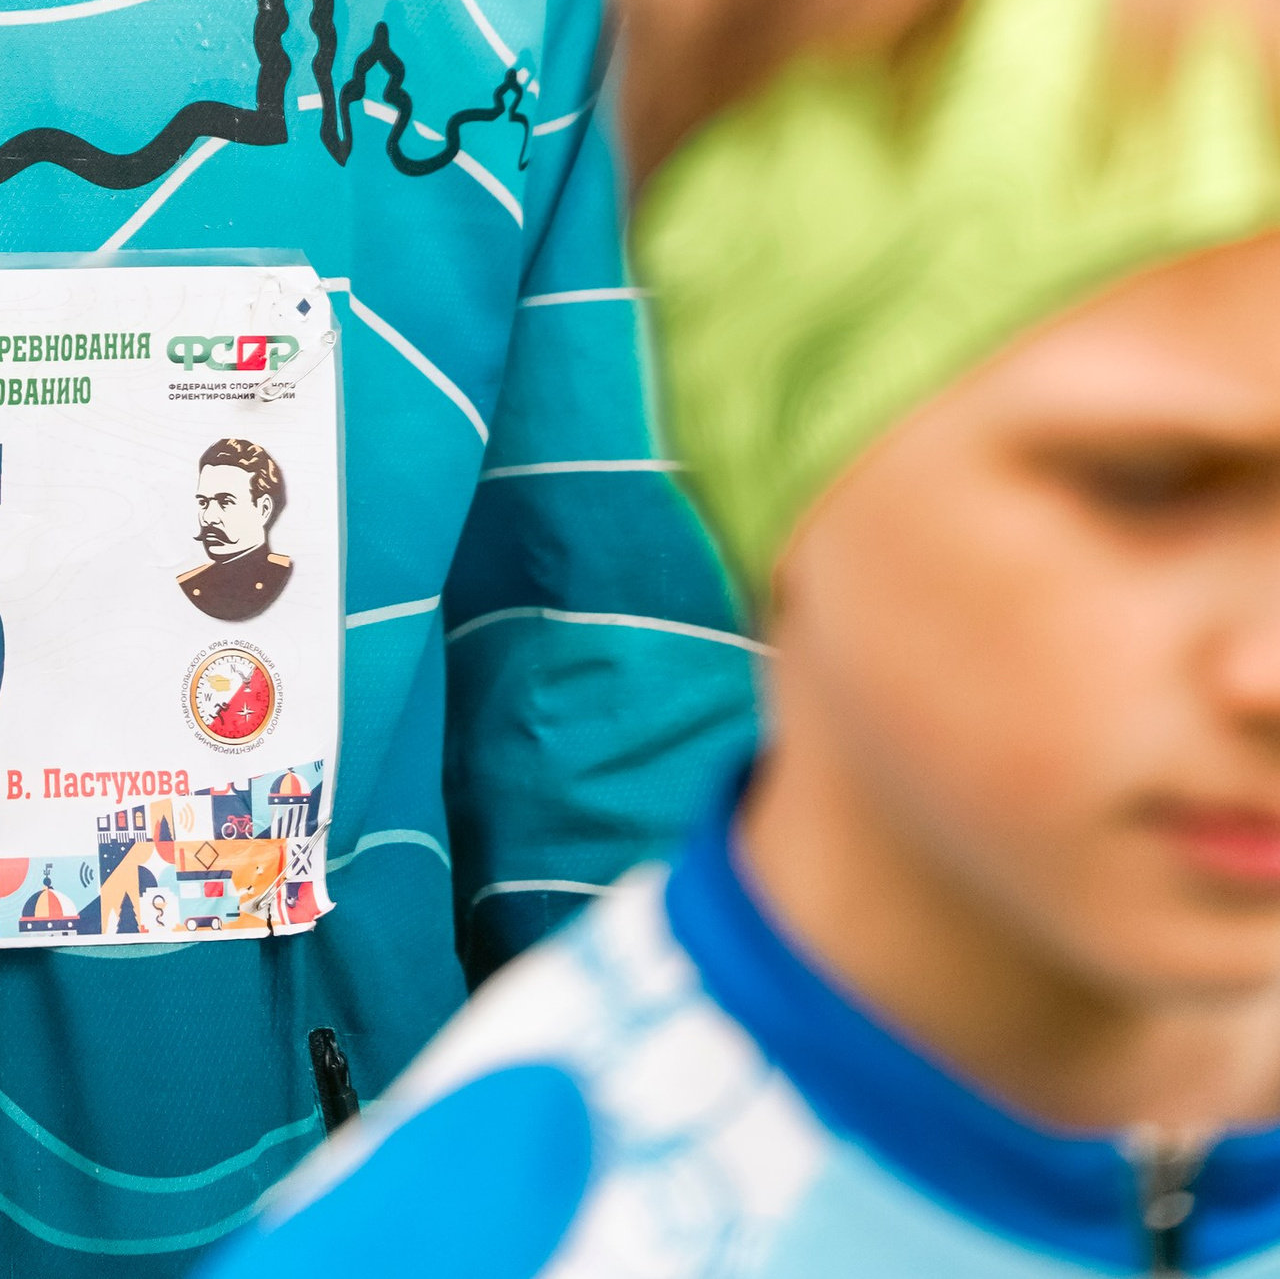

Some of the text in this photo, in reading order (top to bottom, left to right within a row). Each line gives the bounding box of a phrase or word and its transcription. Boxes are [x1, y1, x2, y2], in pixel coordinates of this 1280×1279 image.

[168, 382, 296, 391] ФЕДЕРАЦИЯ СПОРТНОГО
[168, 392, 255, 401] ОРИЕНТИРОВАНИЯ
[7, 769, 31, 800] В.
[43, 768, 190, 804] Пастухова
